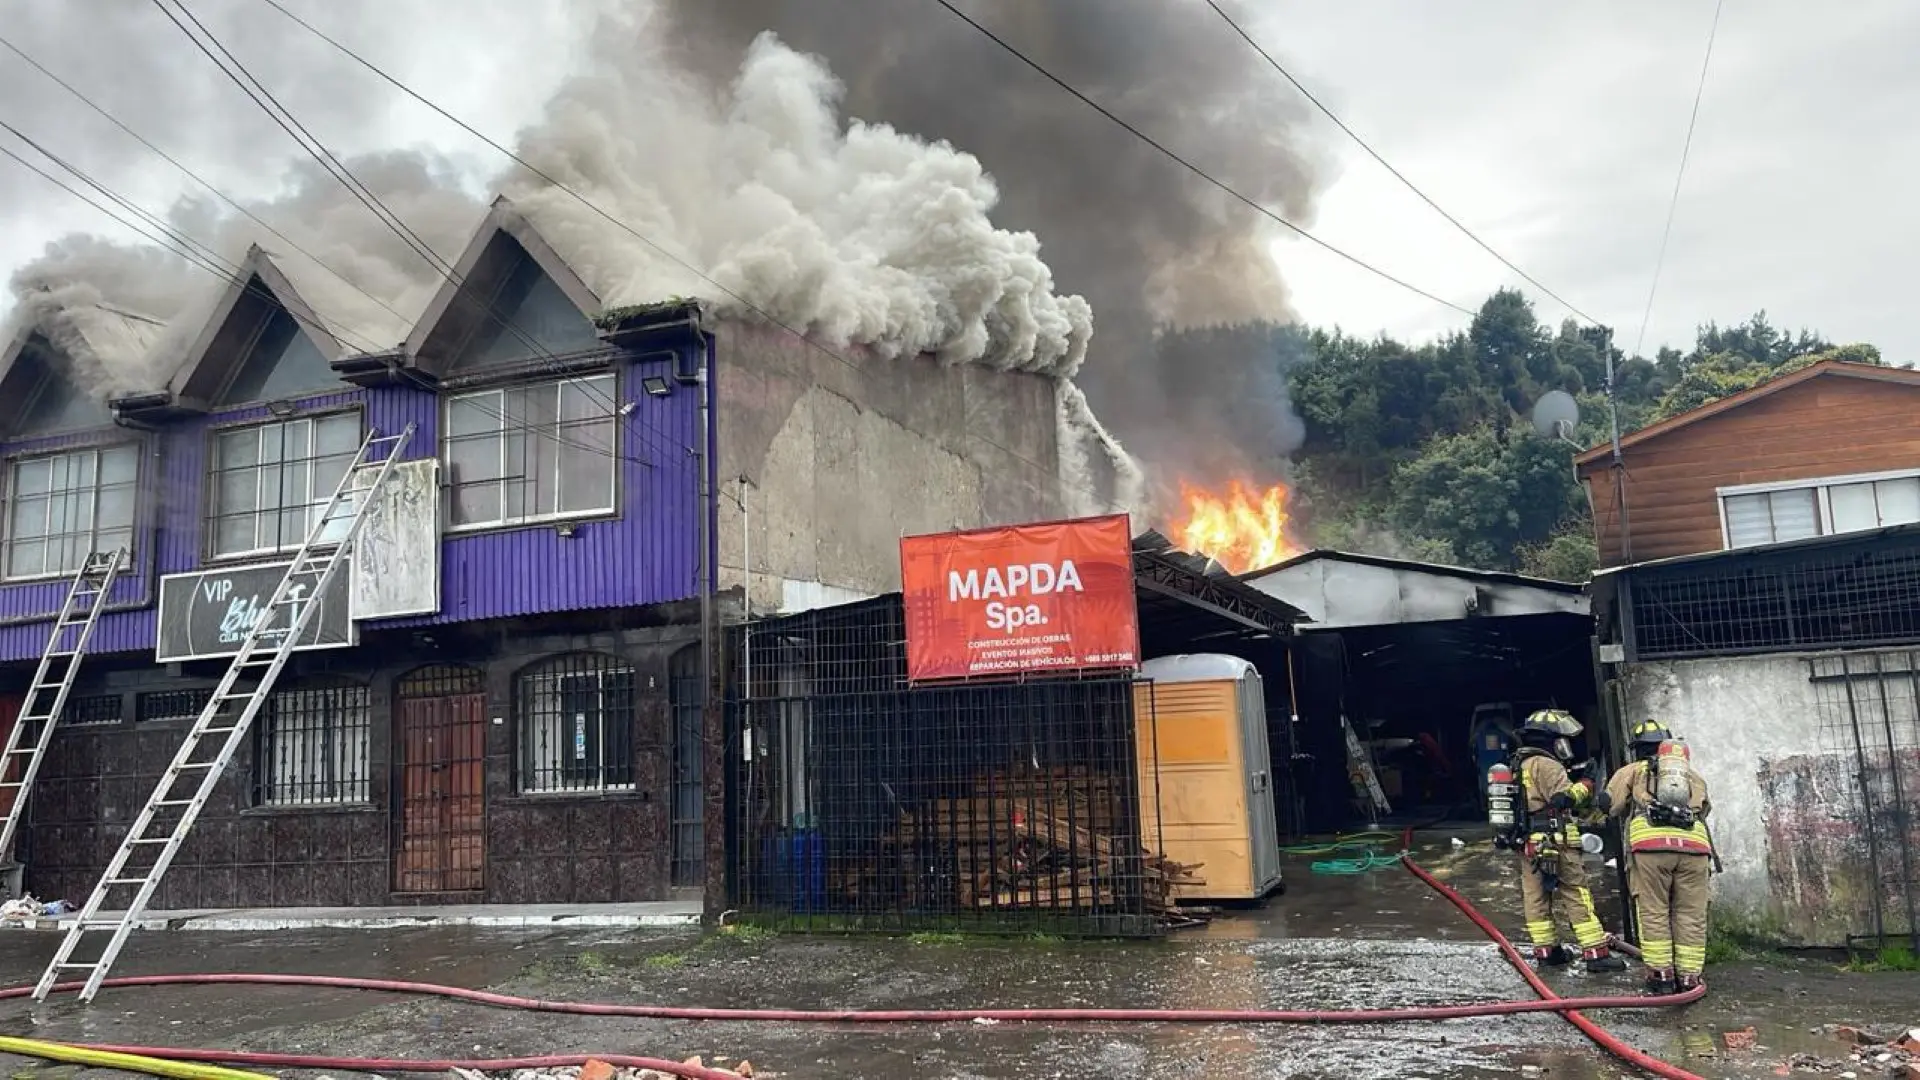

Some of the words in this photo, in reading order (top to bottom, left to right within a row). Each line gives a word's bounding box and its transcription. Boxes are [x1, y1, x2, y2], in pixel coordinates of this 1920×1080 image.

[204, 579, 233, 603] VIP
[949, 560, 1084, 602] MAPDA
[986, 602, 1048, 634] Spa.
